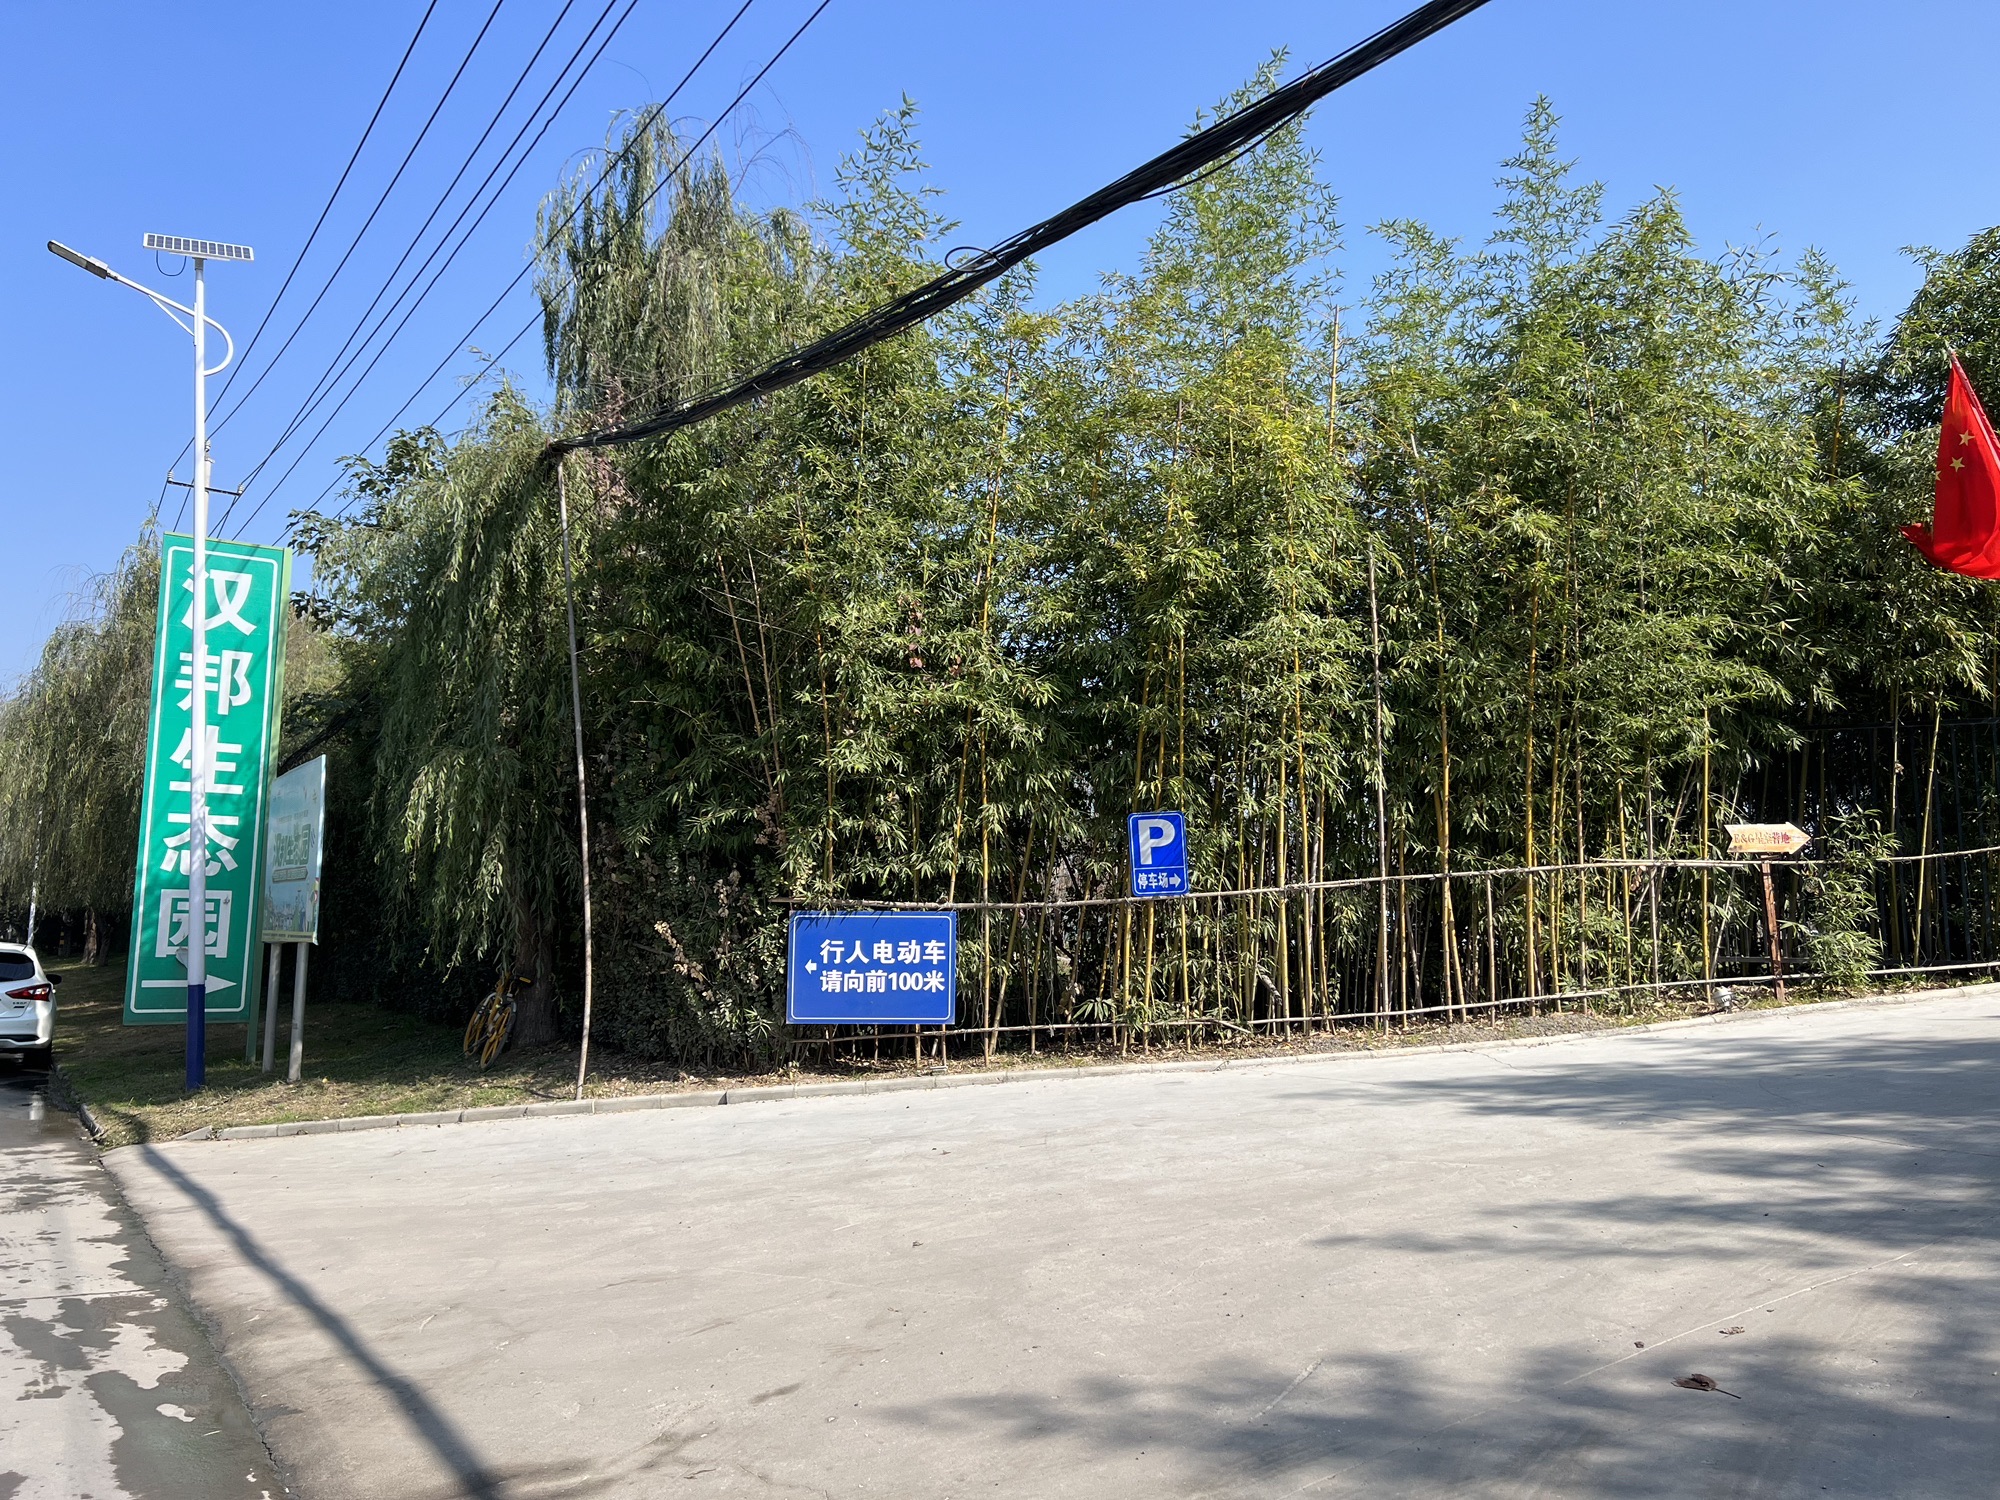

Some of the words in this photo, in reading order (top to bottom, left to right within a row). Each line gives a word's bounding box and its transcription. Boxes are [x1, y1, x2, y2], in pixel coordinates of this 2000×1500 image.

[154, 562, 257, 959] 汉邦生态园
[1138, 819, 1175, 865] P
[1137, 872, 1169, 889] 停车场
[819, 938, 946, 965] 行人电动车
[819, 969, 946, 993] 请向前100米
